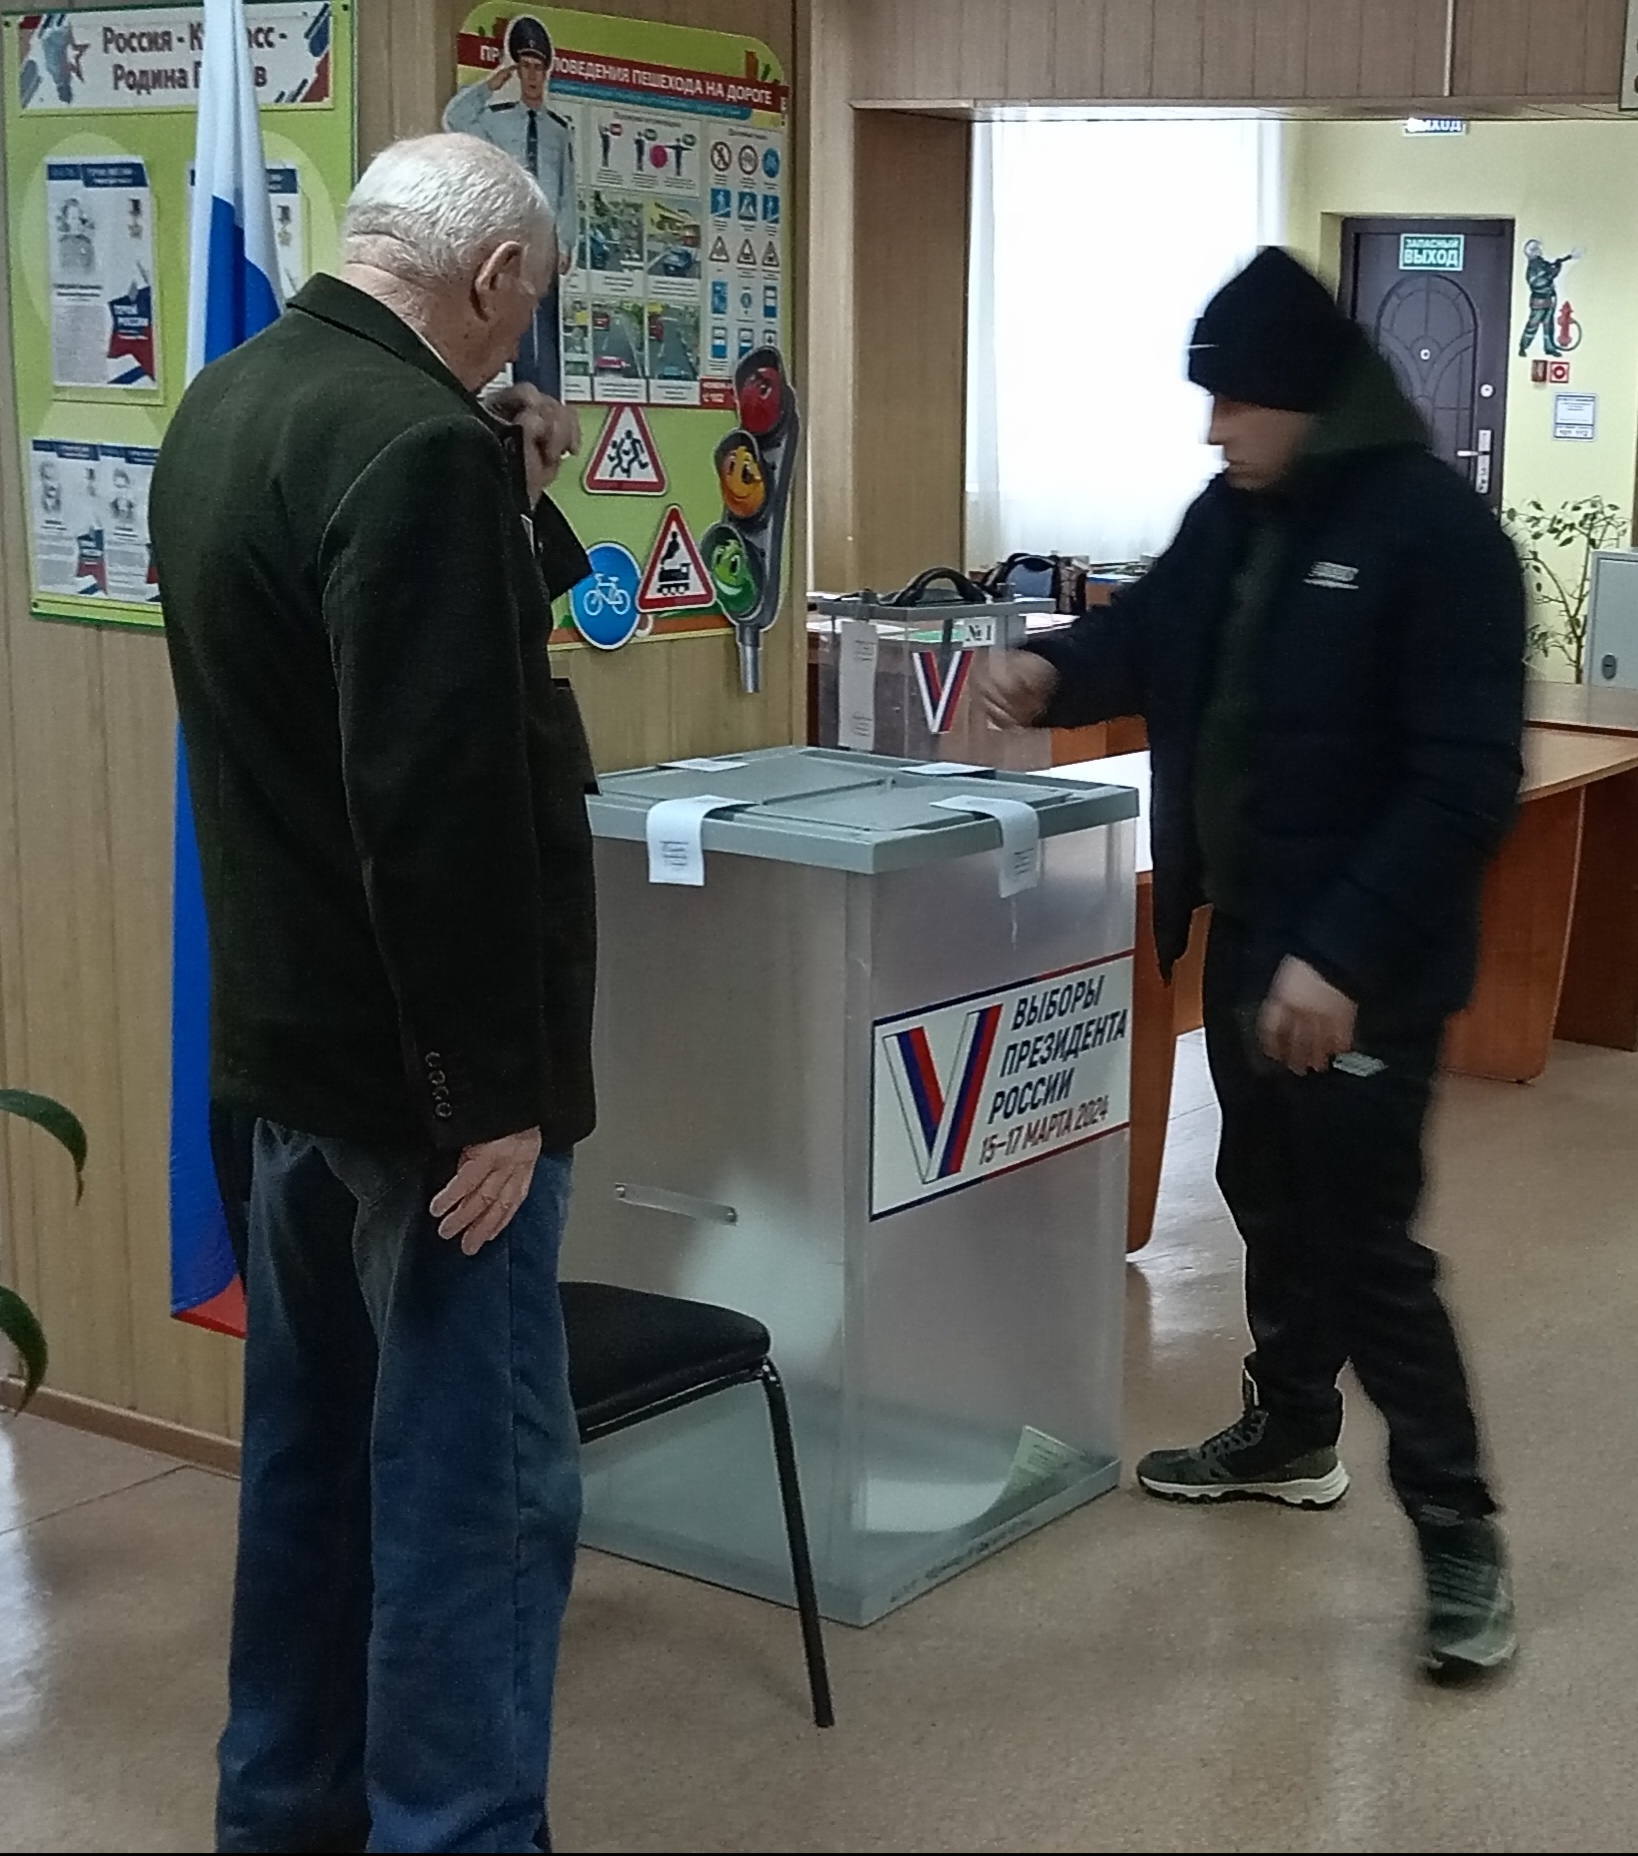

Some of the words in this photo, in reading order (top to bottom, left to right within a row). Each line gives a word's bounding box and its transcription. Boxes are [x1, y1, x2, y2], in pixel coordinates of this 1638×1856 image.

[102, 26, 173, 54] Россия
[112, 62, 189, 96] Родина
[552, 54, 632, 84] ПОВЕДЕНИЯ
[631, 68, 704, 97] ПЕШЕХОДА
[705, 82, 726, 98] НА
[726, 83, 774, 106] ДОРОГЕ
[1403, 249, 1460, 267] ВЫХОД
[1405, 237, 1460, 249] ЗАПАСНЫЙ
[1010, 974, 1106, 1032] ВЫБОРЫ
[999, 1008, 1129, 1078] ПРЕЗИДЕНТА
[987, 1066, 1076, 1126] РОССИИ
[1021, 1107, 1073, 1151] МАРТА
[1073, 1094, 1110, 1131] 2024
